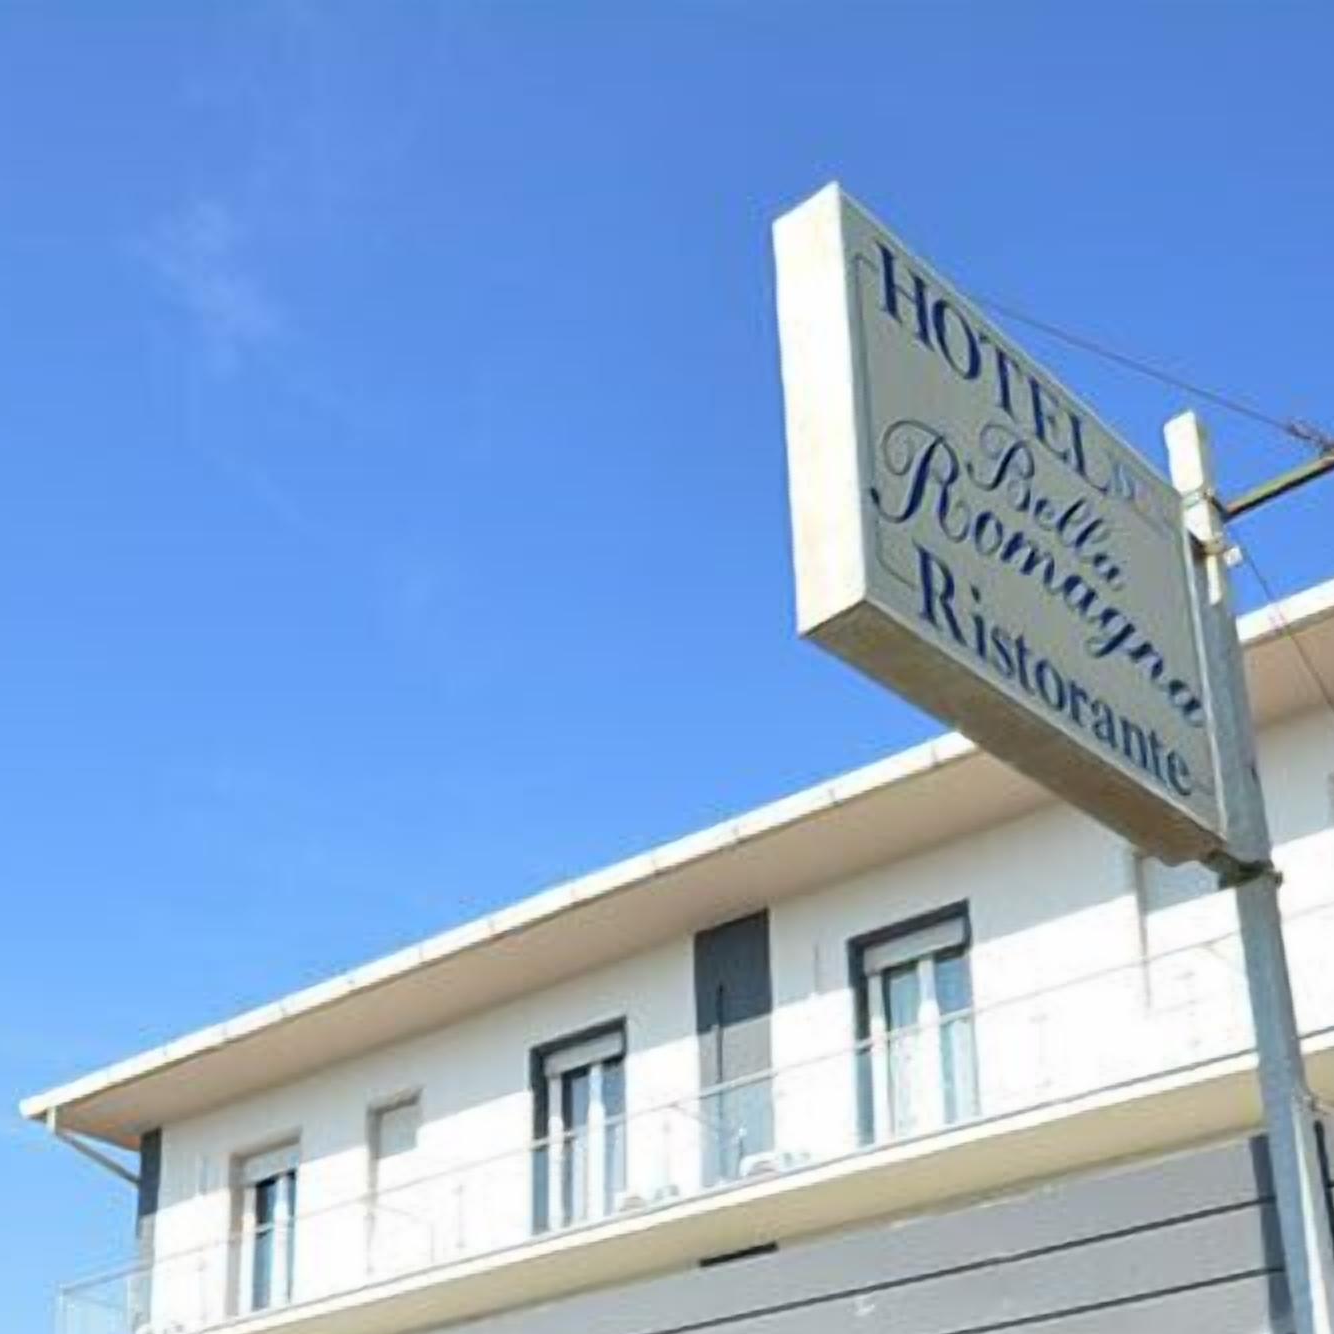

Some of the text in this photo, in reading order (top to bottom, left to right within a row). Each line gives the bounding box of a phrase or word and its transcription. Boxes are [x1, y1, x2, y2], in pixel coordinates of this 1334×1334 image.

[875, 240, 1108, 496] HOTEL
[870, 420, 1205, 728] Romagna
[967, 423, 1124, 592] Bella
[916, 544, 1192, 797] Ristorante
